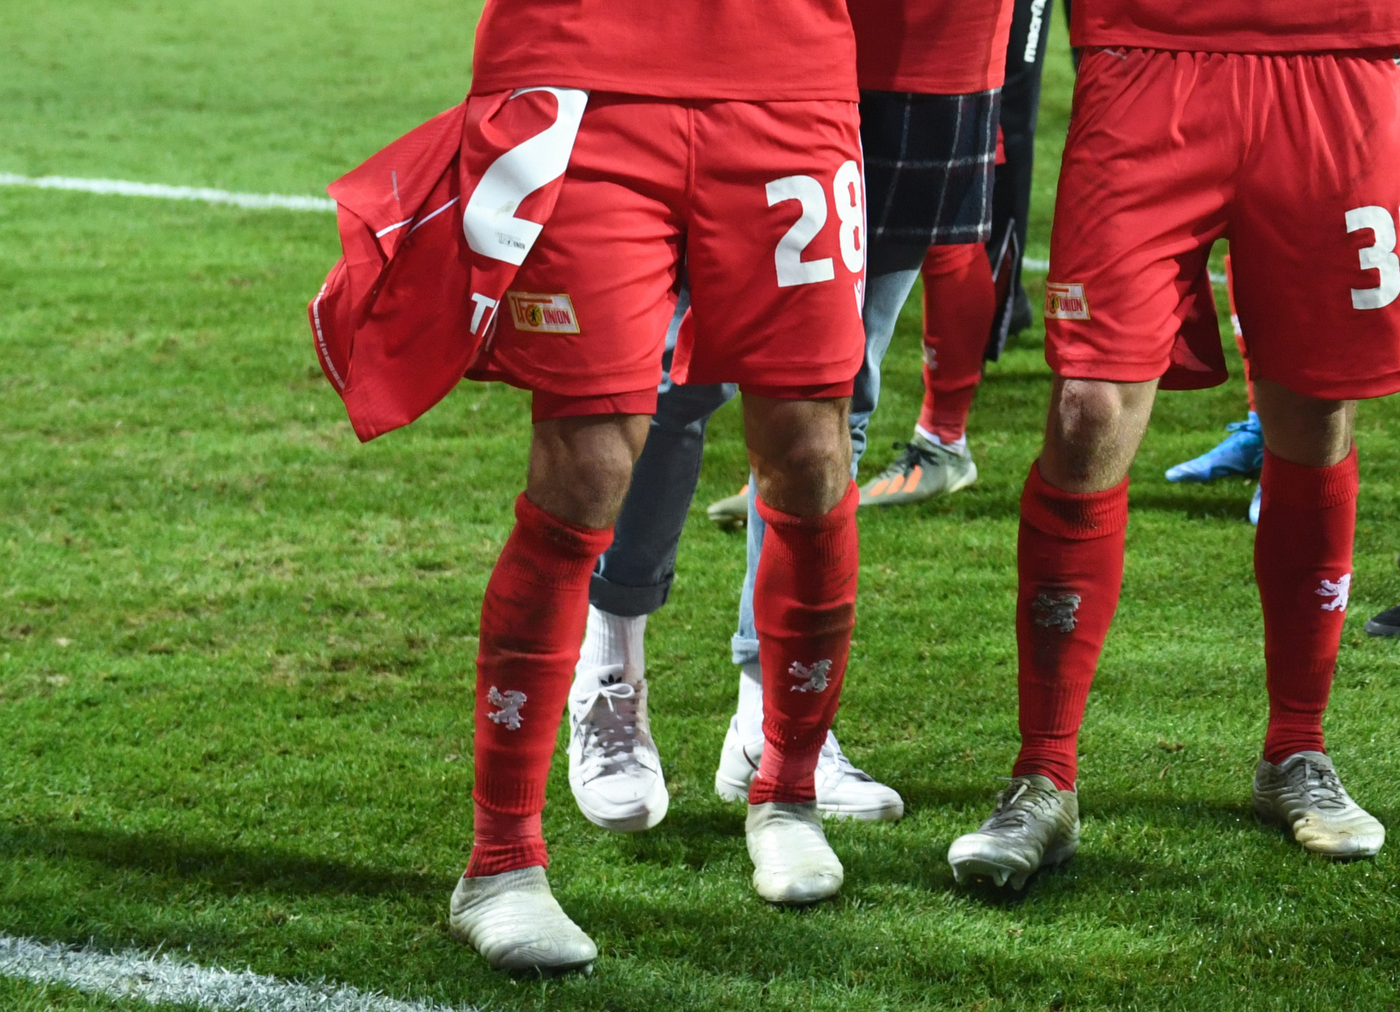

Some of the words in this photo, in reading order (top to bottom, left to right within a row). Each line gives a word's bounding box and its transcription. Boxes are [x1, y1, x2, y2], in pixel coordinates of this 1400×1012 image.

[764, 159, 865, 288] 28
[1060, 298, 1083, 312] UNION
[542, 308, 571, 326] UNION
